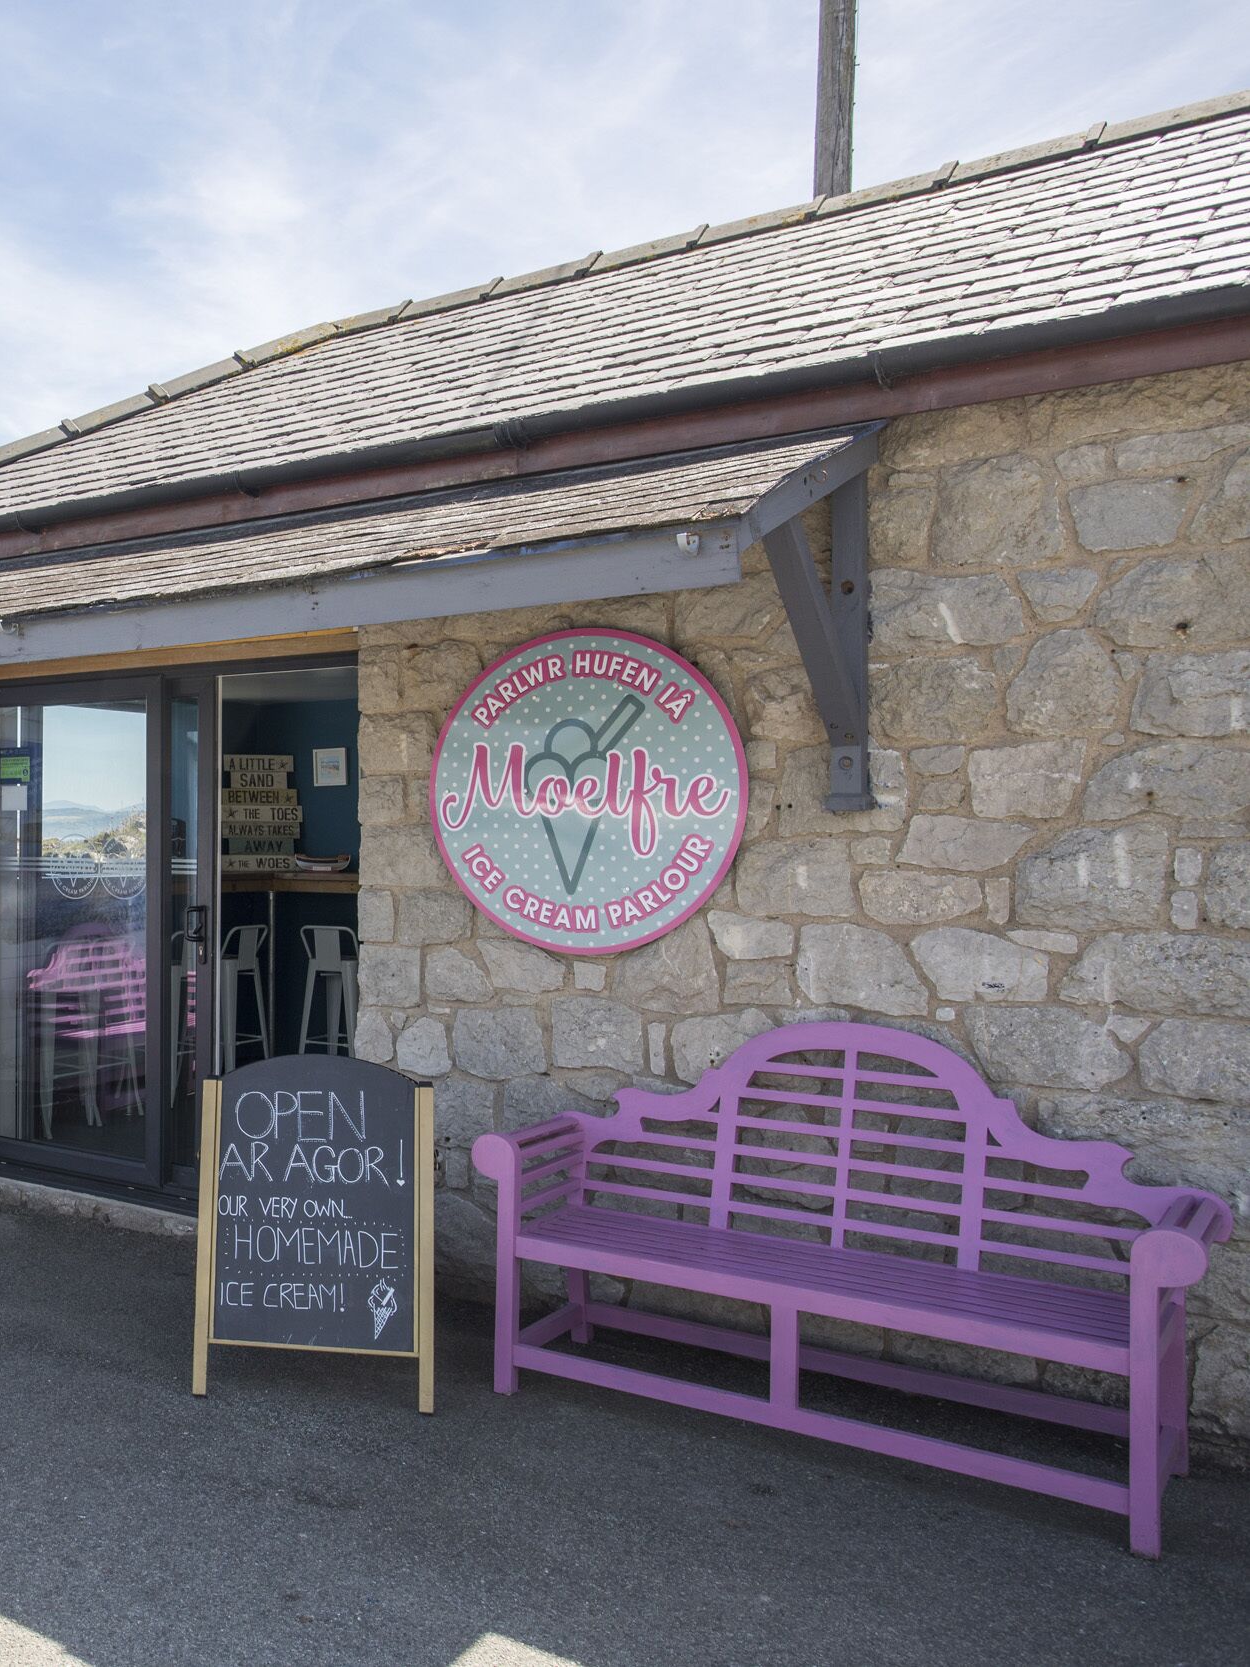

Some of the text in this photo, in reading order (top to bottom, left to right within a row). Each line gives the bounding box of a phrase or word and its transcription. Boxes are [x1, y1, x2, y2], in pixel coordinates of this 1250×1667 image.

[476, 652, 692, 726] PARLWR HUFEN IÂ
[229, 758, 275, 770] A LITTLE
[240, 773, 274, 787] SAND
[228, 791, 279, 804] BETWEEN
[440, 742, 731, 858] Moelfre
[243, 808, 298, 821] THE TOES
[229, 825, 294, 836] ALWAYS TAKES
[244, 841, 283, 852] AWAY
[256, 857, 290, 869] WOES
[464, 836, 709, 930] ICE CREAM PARLOUR
[236, 1090, 366, 1142] OPEN
[219, 1141, 274, 1183] AR
[218, 1194, 248, 1217] OUR
[259, 1196, 298, 1219] VERY
[234, 1224, 399, 1270] HOMEMADE
[220, 1281, 346, 1313] ICE CREAM!
